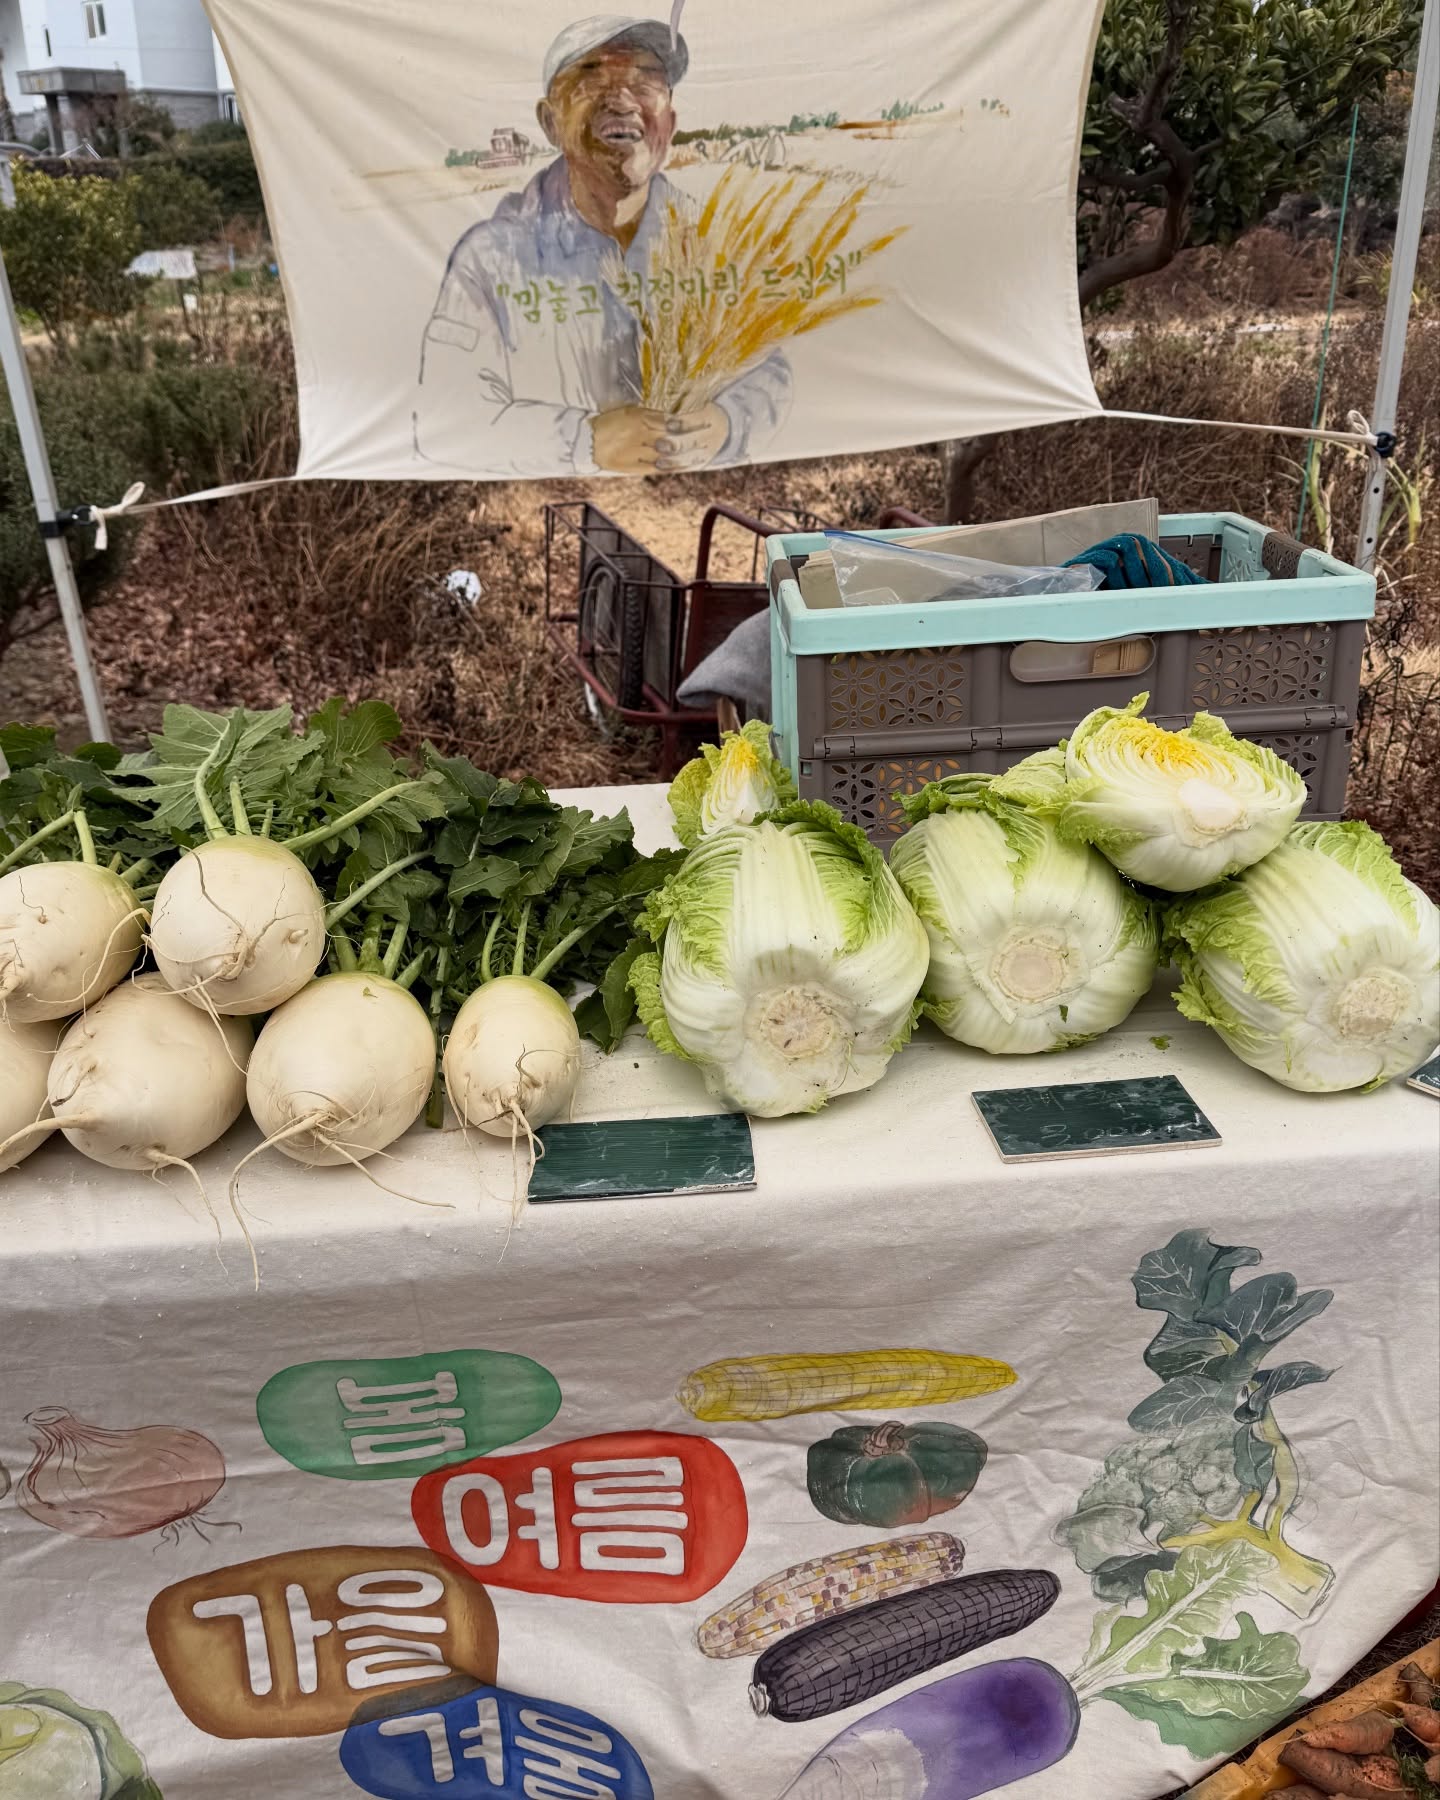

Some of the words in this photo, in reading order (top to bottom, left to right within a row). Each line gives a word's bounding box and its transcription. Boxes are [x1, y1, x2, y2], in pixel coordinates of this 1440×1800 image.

[760, 250, 861, 299] 드십서"
[336, 1371, 468, 1466] 봄
[441, 1456, 689, 1576] 여름
[192, 1570, 453, 1697] 가을
